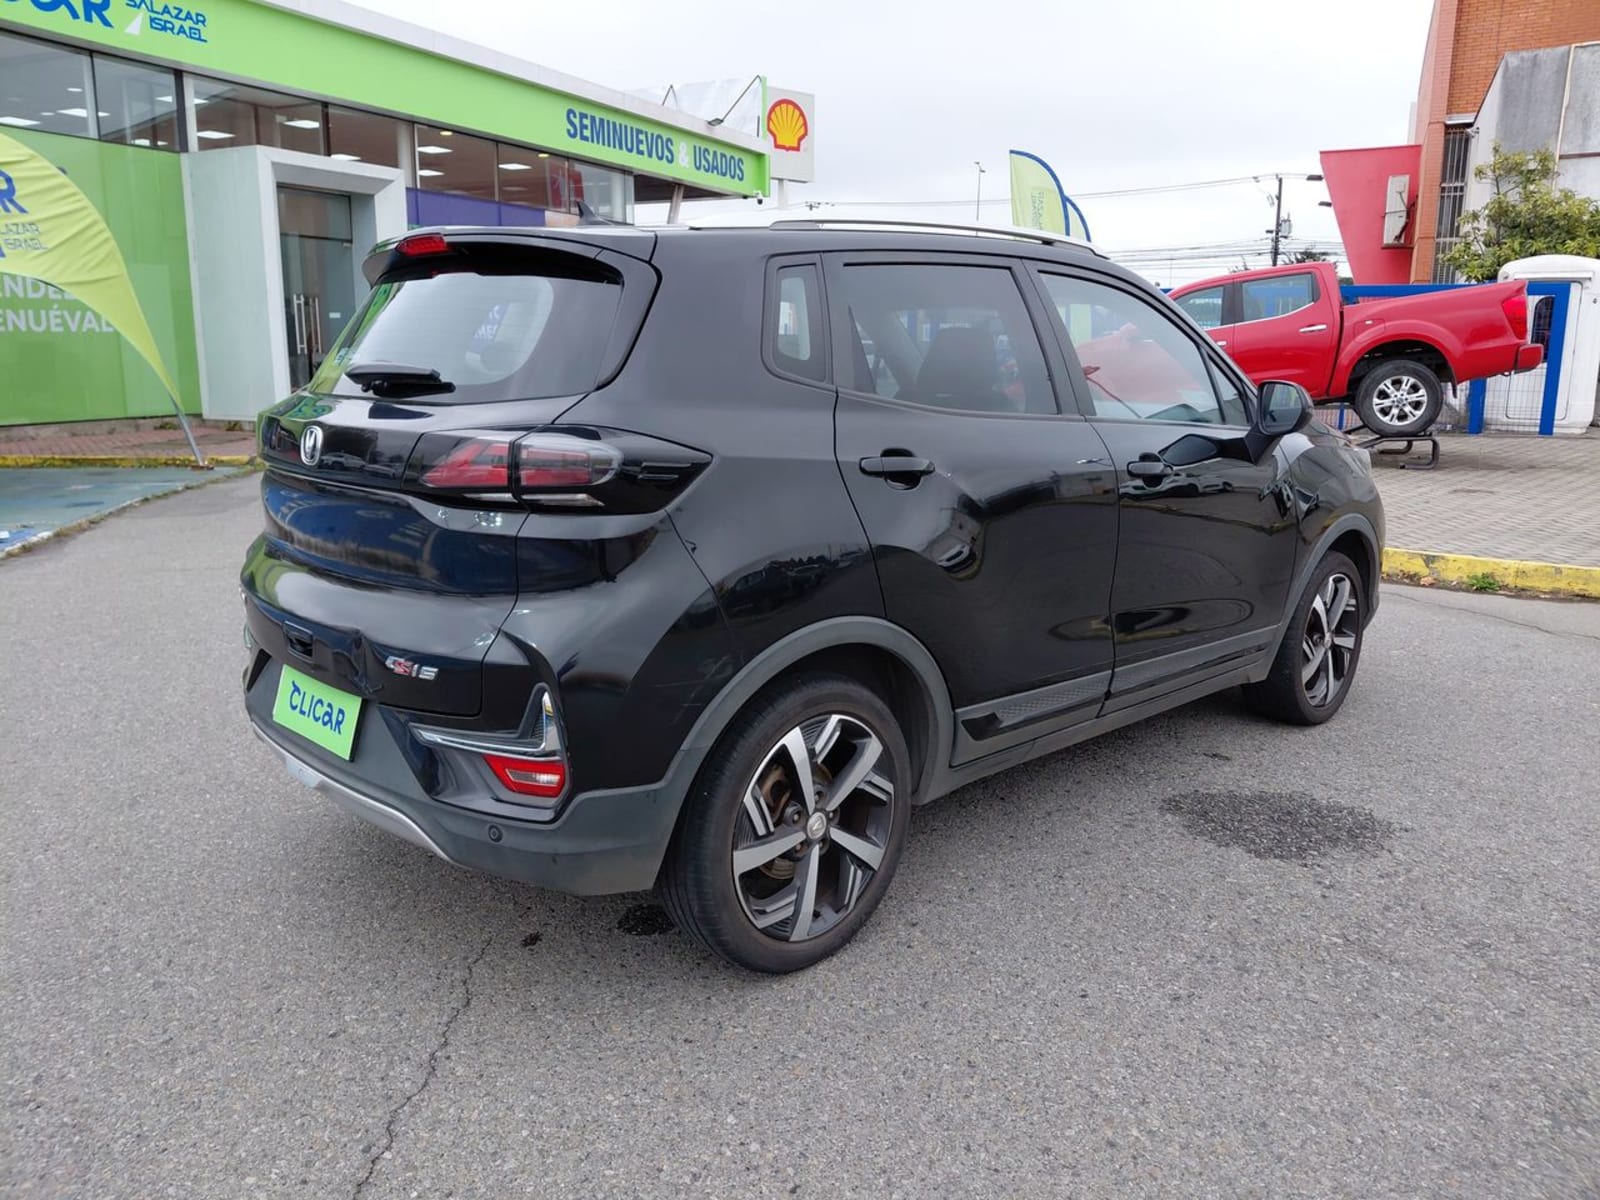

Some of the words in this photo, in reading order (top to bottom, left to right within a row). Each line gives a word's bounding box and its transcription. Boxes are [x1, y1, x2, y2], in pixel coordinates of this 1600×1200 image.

[149, 15, 208, 43] ISRAEL
[566, 108, 675, 165] SEMINUEVOS
[678, 141, 689, 169] &
[693, 145, 745, 182] USADOS
